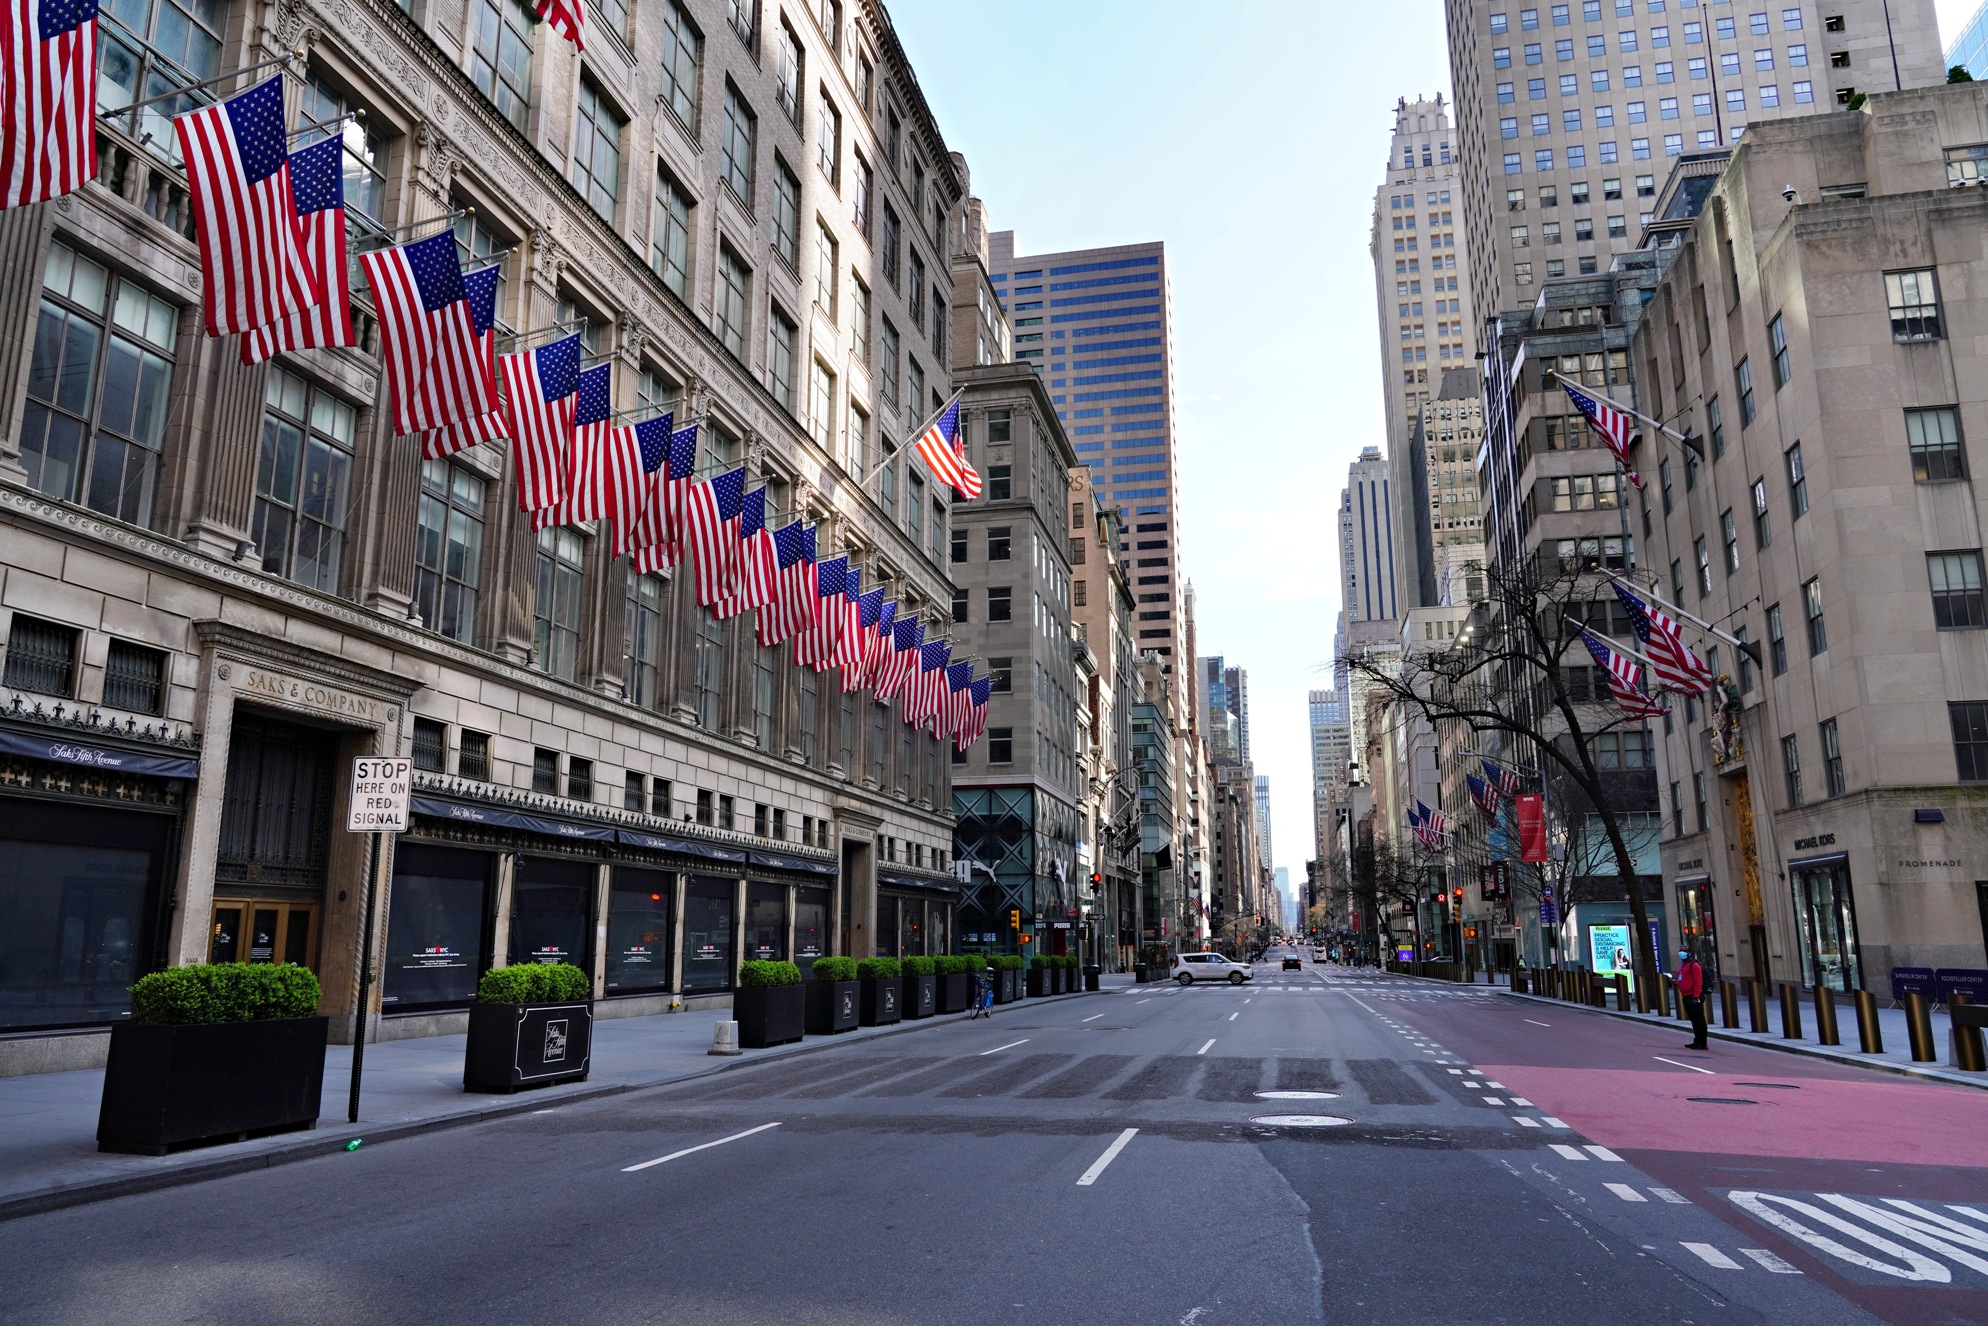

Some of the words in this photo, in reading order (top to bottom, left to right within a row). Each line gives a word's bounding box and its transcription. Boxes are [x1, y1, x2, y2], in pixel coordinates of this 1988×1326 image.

[248, 672, 286, 695] SAKS
[290, 683, 298, 697] &
[304, 687, 377, 717] COMPANY
[48, 744, 74, 758] Saks
[73, 747, 93, 763] Fifth
[91, 750, 122, 766] Avenue
[357, 762, 407, 779] STOP
[356, 782, 385, 794] HERE
[391, 782, 406, 794] ON
[366, 798, 392, 809] RED
[354, 813, 401, 824] SIGNAL
[1794, 836, 1817, 851] MICHAEL
[1818, 833, 1836, 847] KORS
[1898, 860, 1962, 868] PROMENADE
